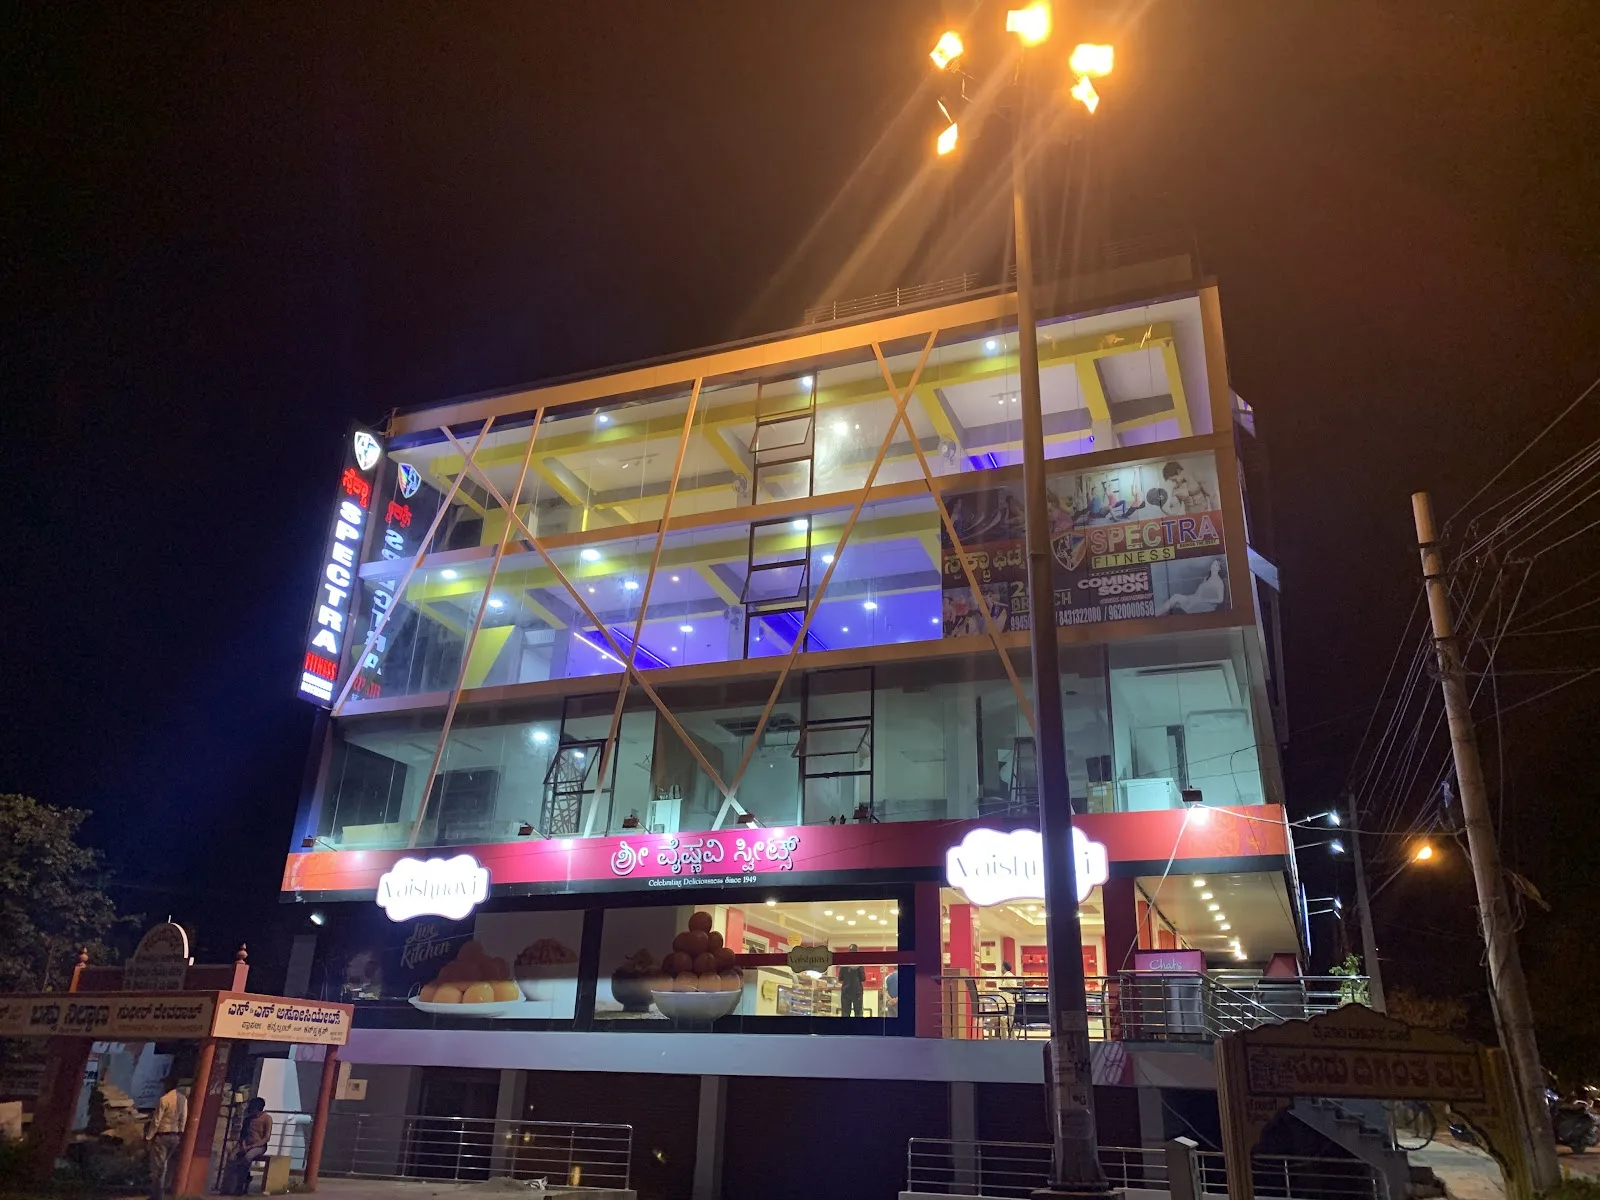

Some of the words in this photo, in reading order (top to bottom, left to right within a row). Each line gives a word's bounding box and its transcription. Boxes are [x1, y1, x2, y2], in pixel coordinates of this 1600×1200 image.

[1090, 516, 1219, 554] SPECTRA
[1092, 547, 1172, 568] FITNESS
[312, 500, 362, 654] SPECTRA
[1077, 572, 1149, 591] COMING
[1098, 580, 1149, 596] SOON
[304, 652, 337, 680] FITNESS
[611, 840, 649, 876] ಶ್ರೀ
[657, 838, 725, 874] ವೈಷ್ಣವಿ
[734, 835, 801, 872] ಸ್ವೀಟ್ಸ್
[743, 875, 757, 883] 1949
[1149, 959, 1183, 970] Chats
